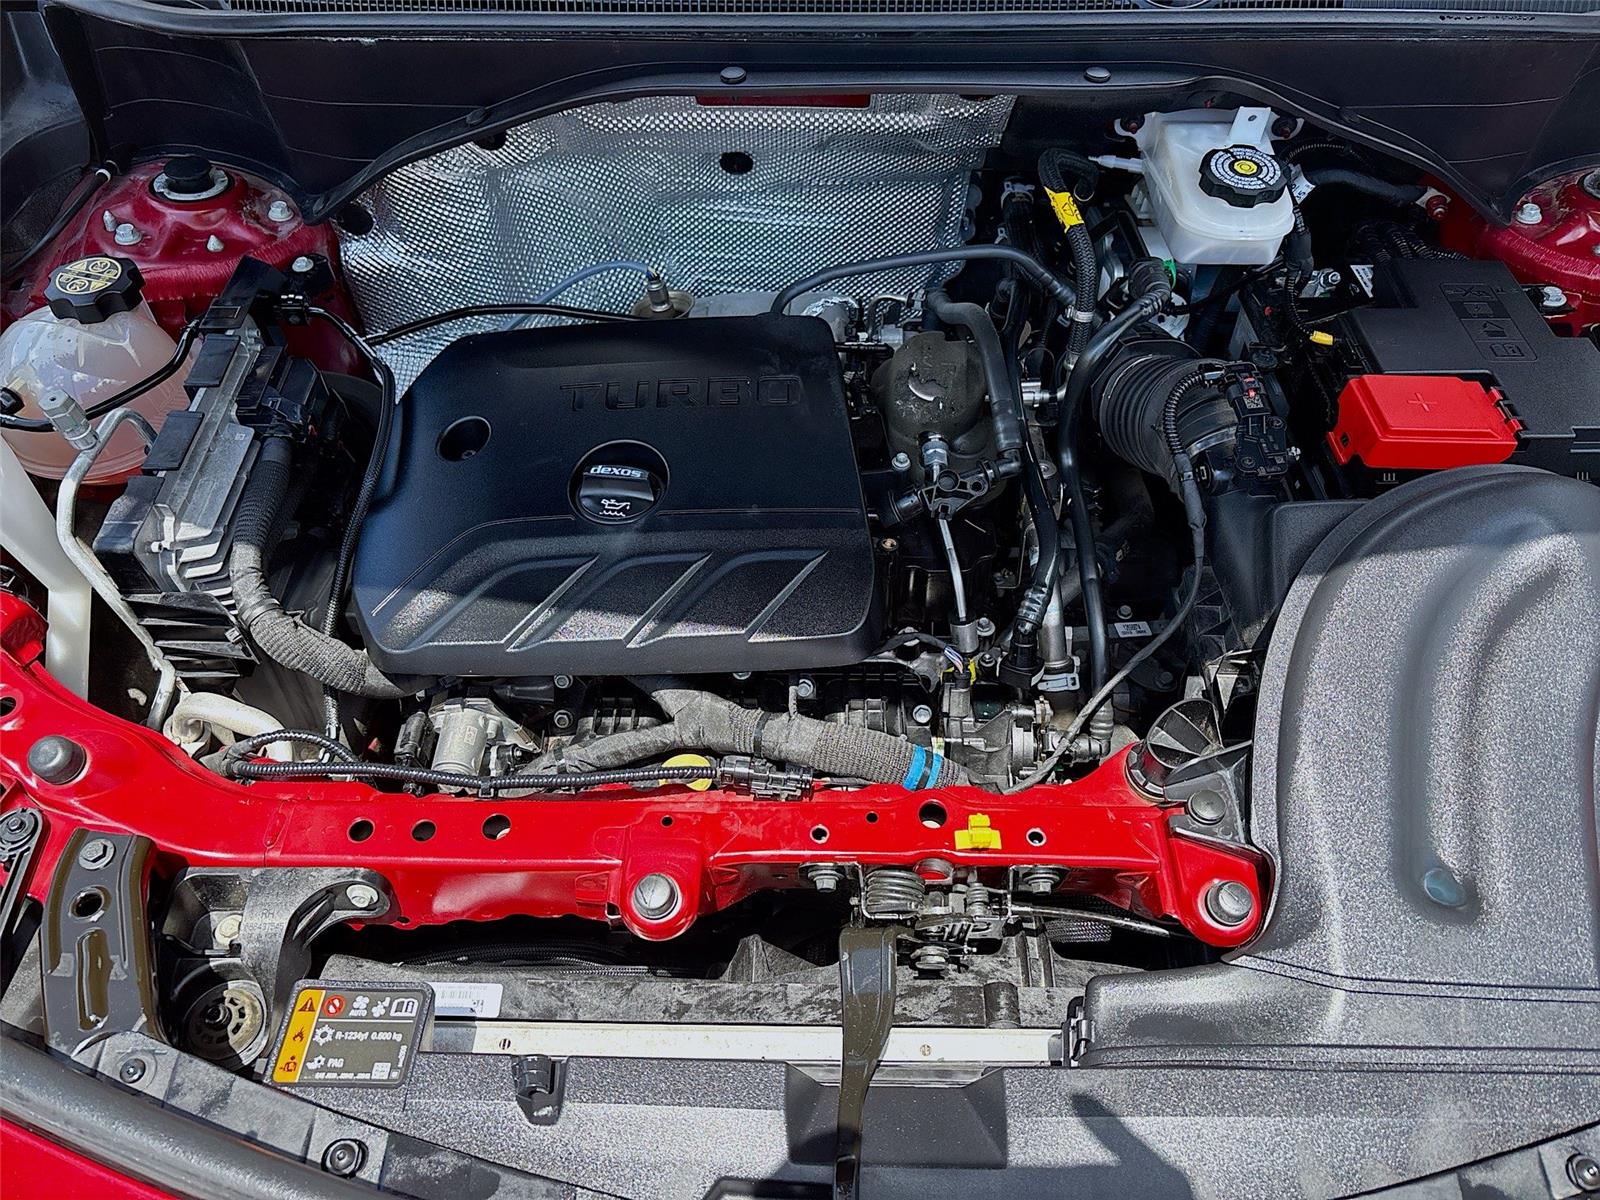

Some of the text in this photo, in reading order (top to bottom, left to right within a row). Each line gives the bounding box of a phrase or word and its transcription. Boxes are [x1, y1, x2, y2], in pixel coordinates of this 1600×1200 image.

[560, 375, 801, 411] TURBO
[590, 465, 643, 478] dexos
[392, 1031, 403, 1042] kg
